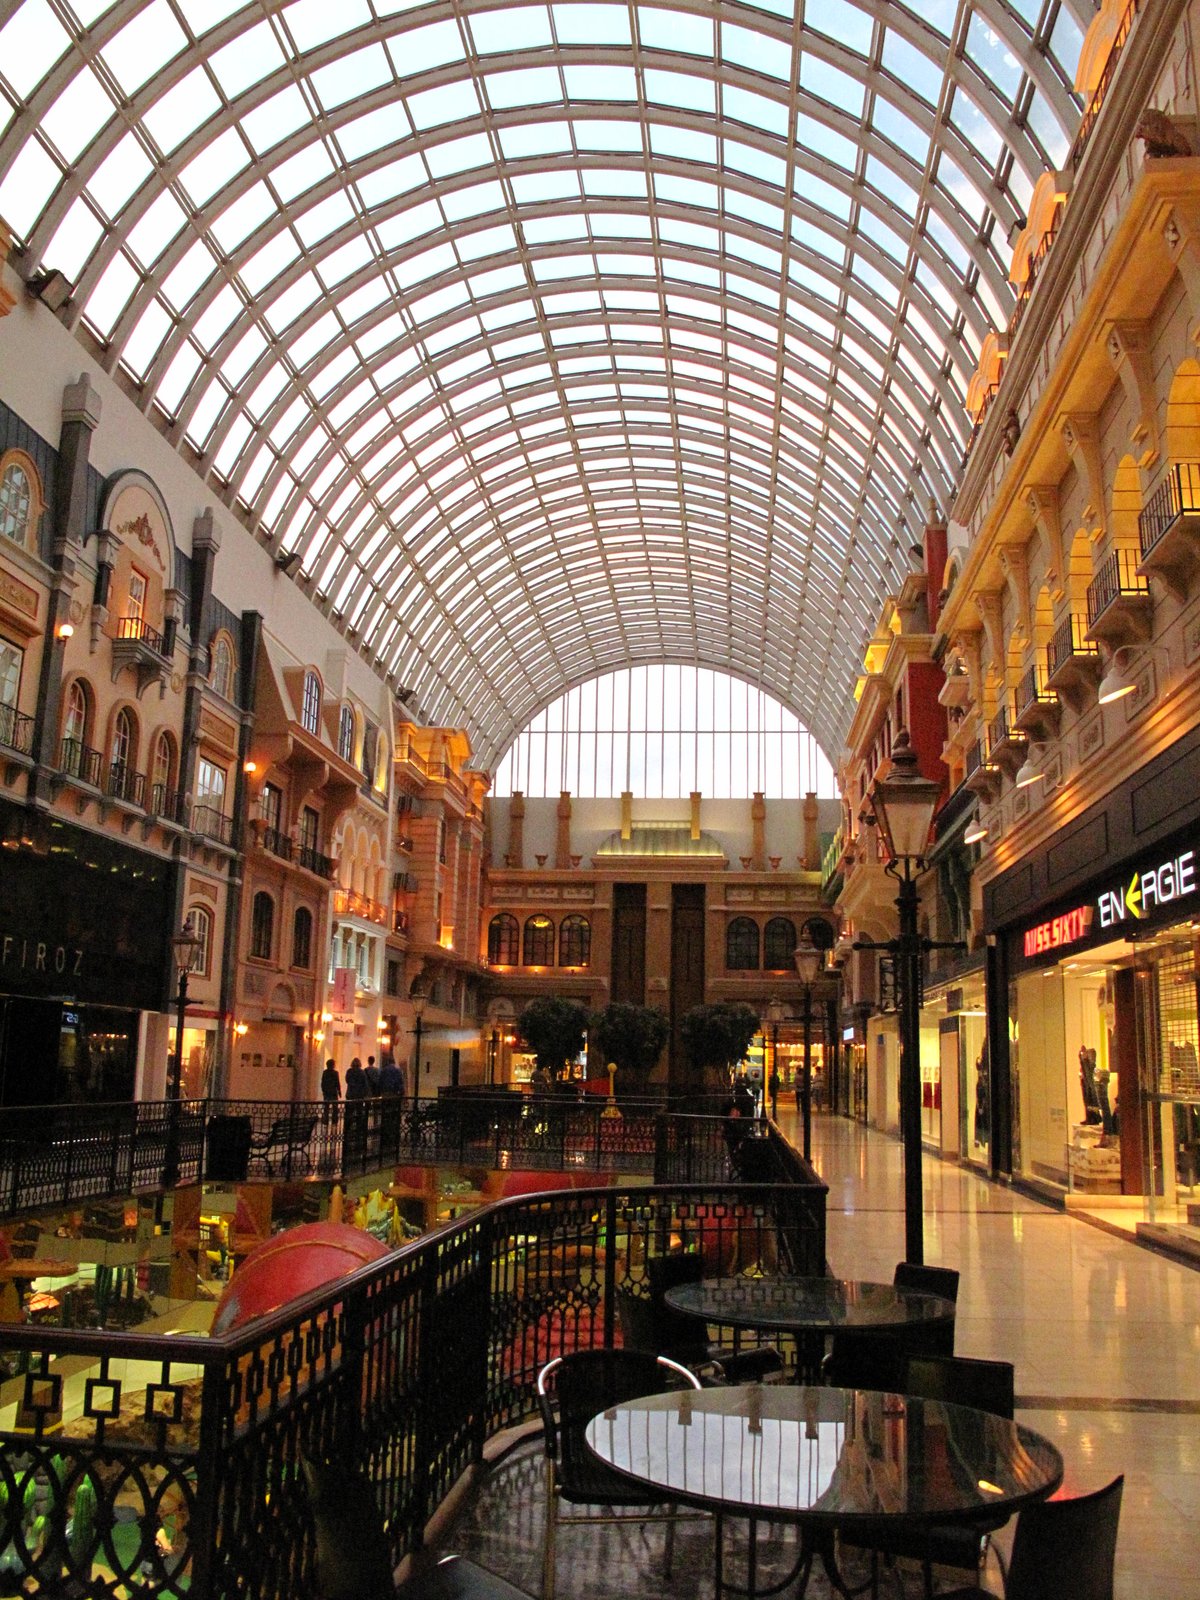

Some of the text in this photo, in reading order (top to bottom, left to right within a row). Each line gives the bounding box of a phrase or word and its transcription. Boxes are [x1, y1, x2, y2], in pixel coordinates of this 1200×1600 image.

[1098, 850, 1196, 928] ENERGIE
[2, 936, 83, 977] FIROZ
[1024, 905, 1089, 957] MISS SIXTY
